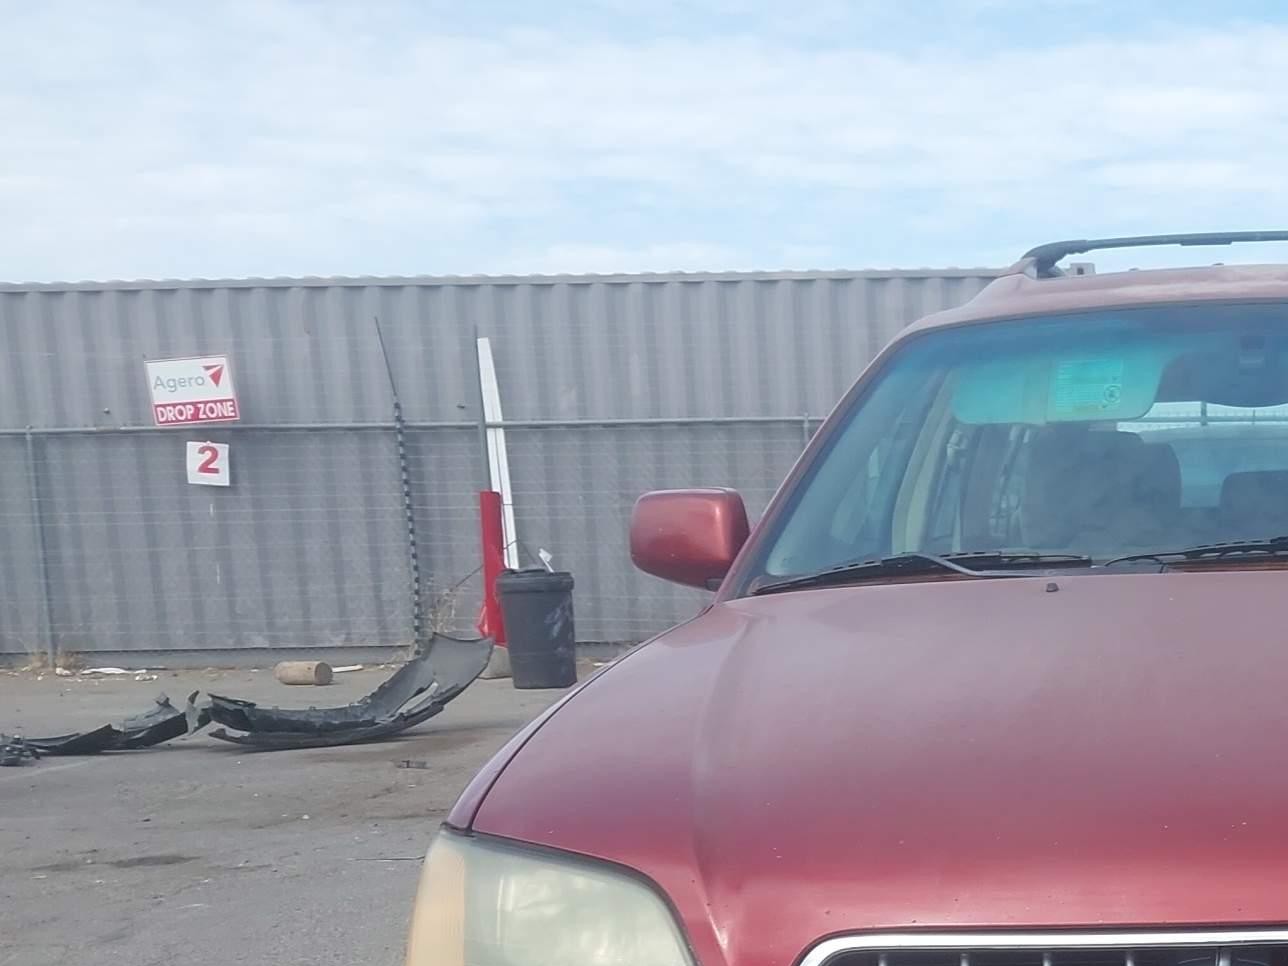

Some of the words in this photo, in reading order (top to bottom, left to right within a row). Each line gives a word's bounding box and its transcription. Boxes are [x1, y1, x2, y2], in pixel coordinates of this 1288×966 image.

[153, 375, 205, 392] Agero
[156, 404, 195, 422] DROP
[197, 402, 236, 420] ZONE
[197, 445, 220, 474] 2
